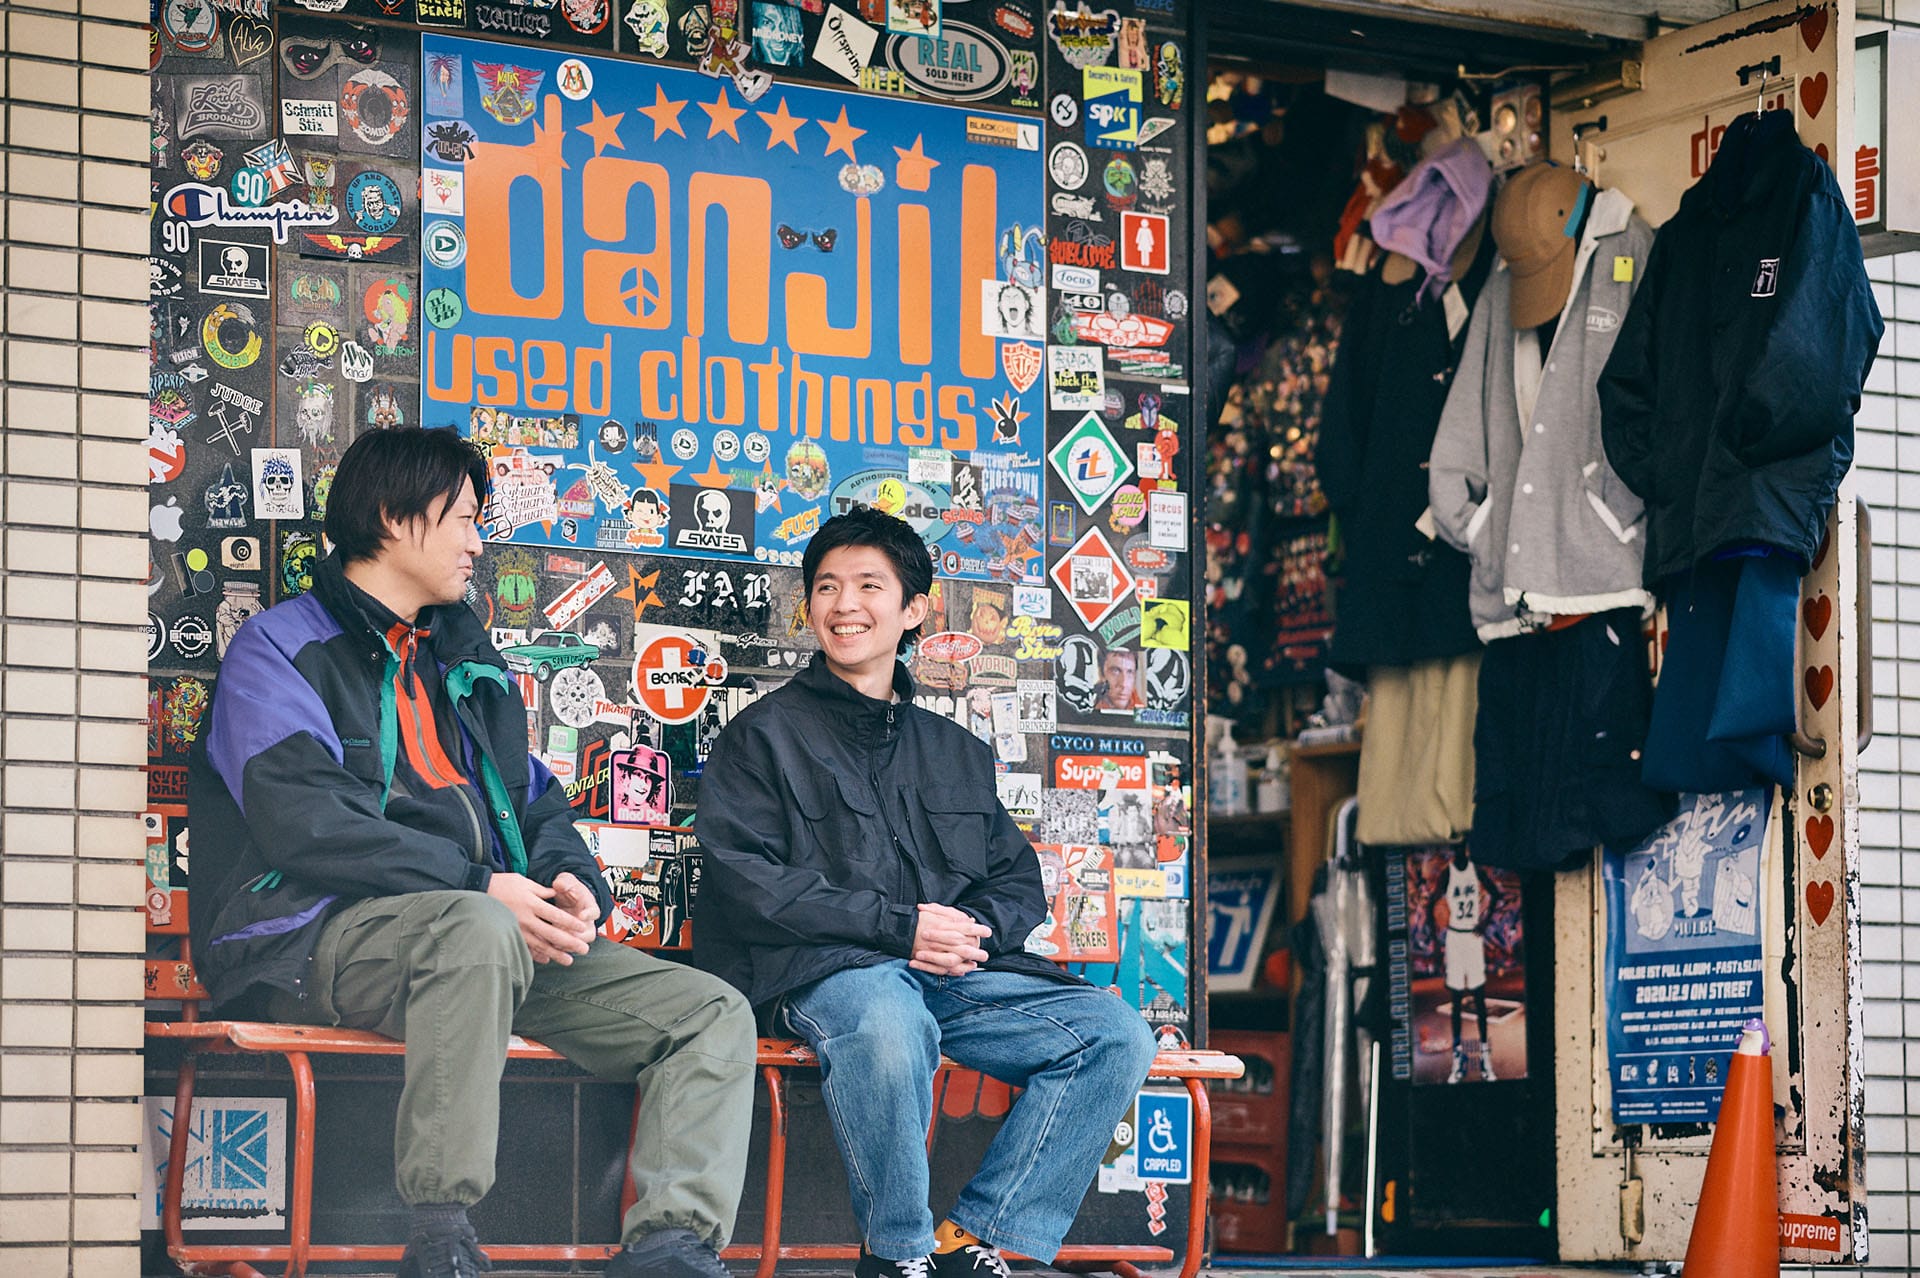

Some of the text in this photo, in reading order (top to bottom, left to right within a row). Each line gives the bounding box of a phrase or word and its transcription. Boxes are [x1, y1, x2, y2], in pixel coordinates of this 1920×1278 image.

[418, 3, 463, 19] BEACH
[917, 37, 982, 73] REAL
[926, 68, 949, 80] SOLD
[951, 71, 975, 84] HERE
[284, 102, 335, 119] Schmitt
[298, 117, 324, 133] Stix
[236, 172, 265, 205] 90
[168, 188, 335, 240] Champion
[162, 220, 191, 254] 90
[1050, 236, 1116, 270] SUBLIME
[207, 276, 258, 288] SKATES
[1059, 271, 1092, 287] focus
[210, 383, 264, 416] JUDGE
[427, 331, 978, 451] used clothings
[942, 507, 985, 525] SCARS
[1153, 503, 1182, 515] CIRCUS
[679, 533, 740, 548] SKATES
[971, 656, 1016, 677] WORLD
[1019, 722, 1056, 733] DRINKER
[1051, 735, 1145, 754] CYCO MIKO
[1060, 757, 1143, 787] Suprme
[1456, 900, 1474, 920] 32
[1708, 980, 1753, 1000] STREET
[1143, 1157, 1182, 1174] CRIPPLED
[1777, 1215, 1837, 1246] Supreme
